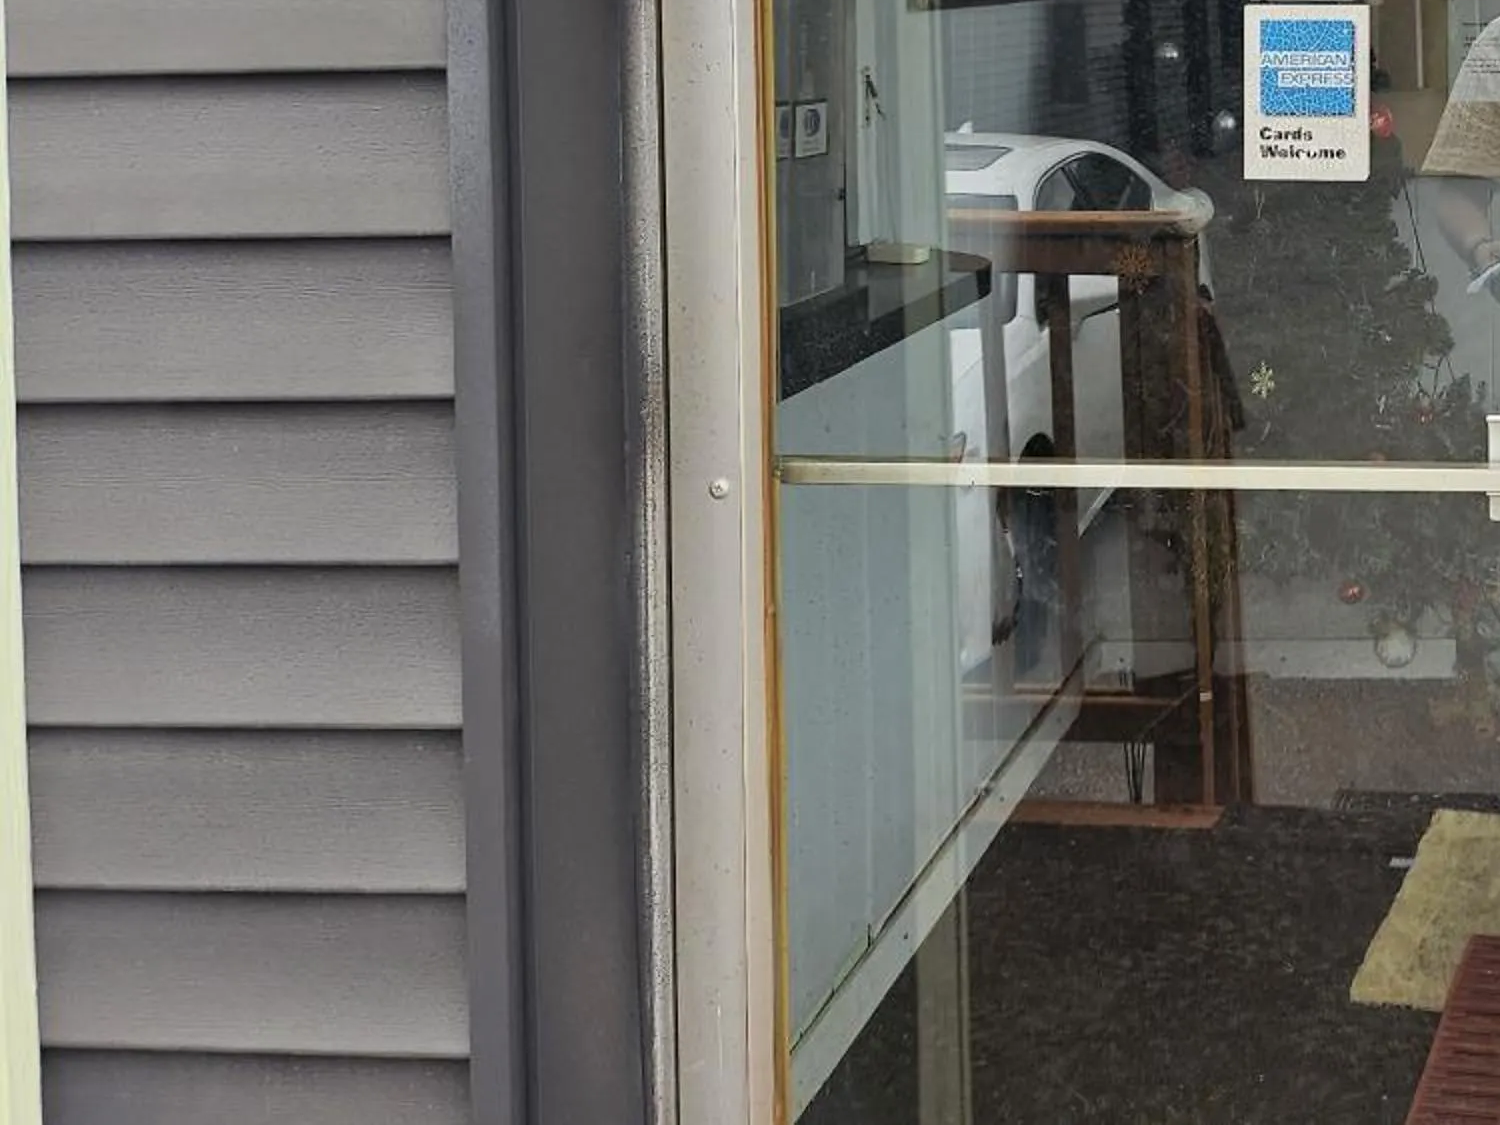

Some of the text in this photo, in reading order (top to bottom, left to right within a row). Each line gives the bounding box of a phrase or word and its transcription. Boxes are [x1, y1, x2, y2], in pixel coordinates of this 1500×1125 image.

[1261, 52, 1348, 67] AMERICAN
[1280, 71, 1354, 86] EXPRESS
[1259, 126, 1313, 141] Cards
[1260, 145, 1347, 160] Welcome
